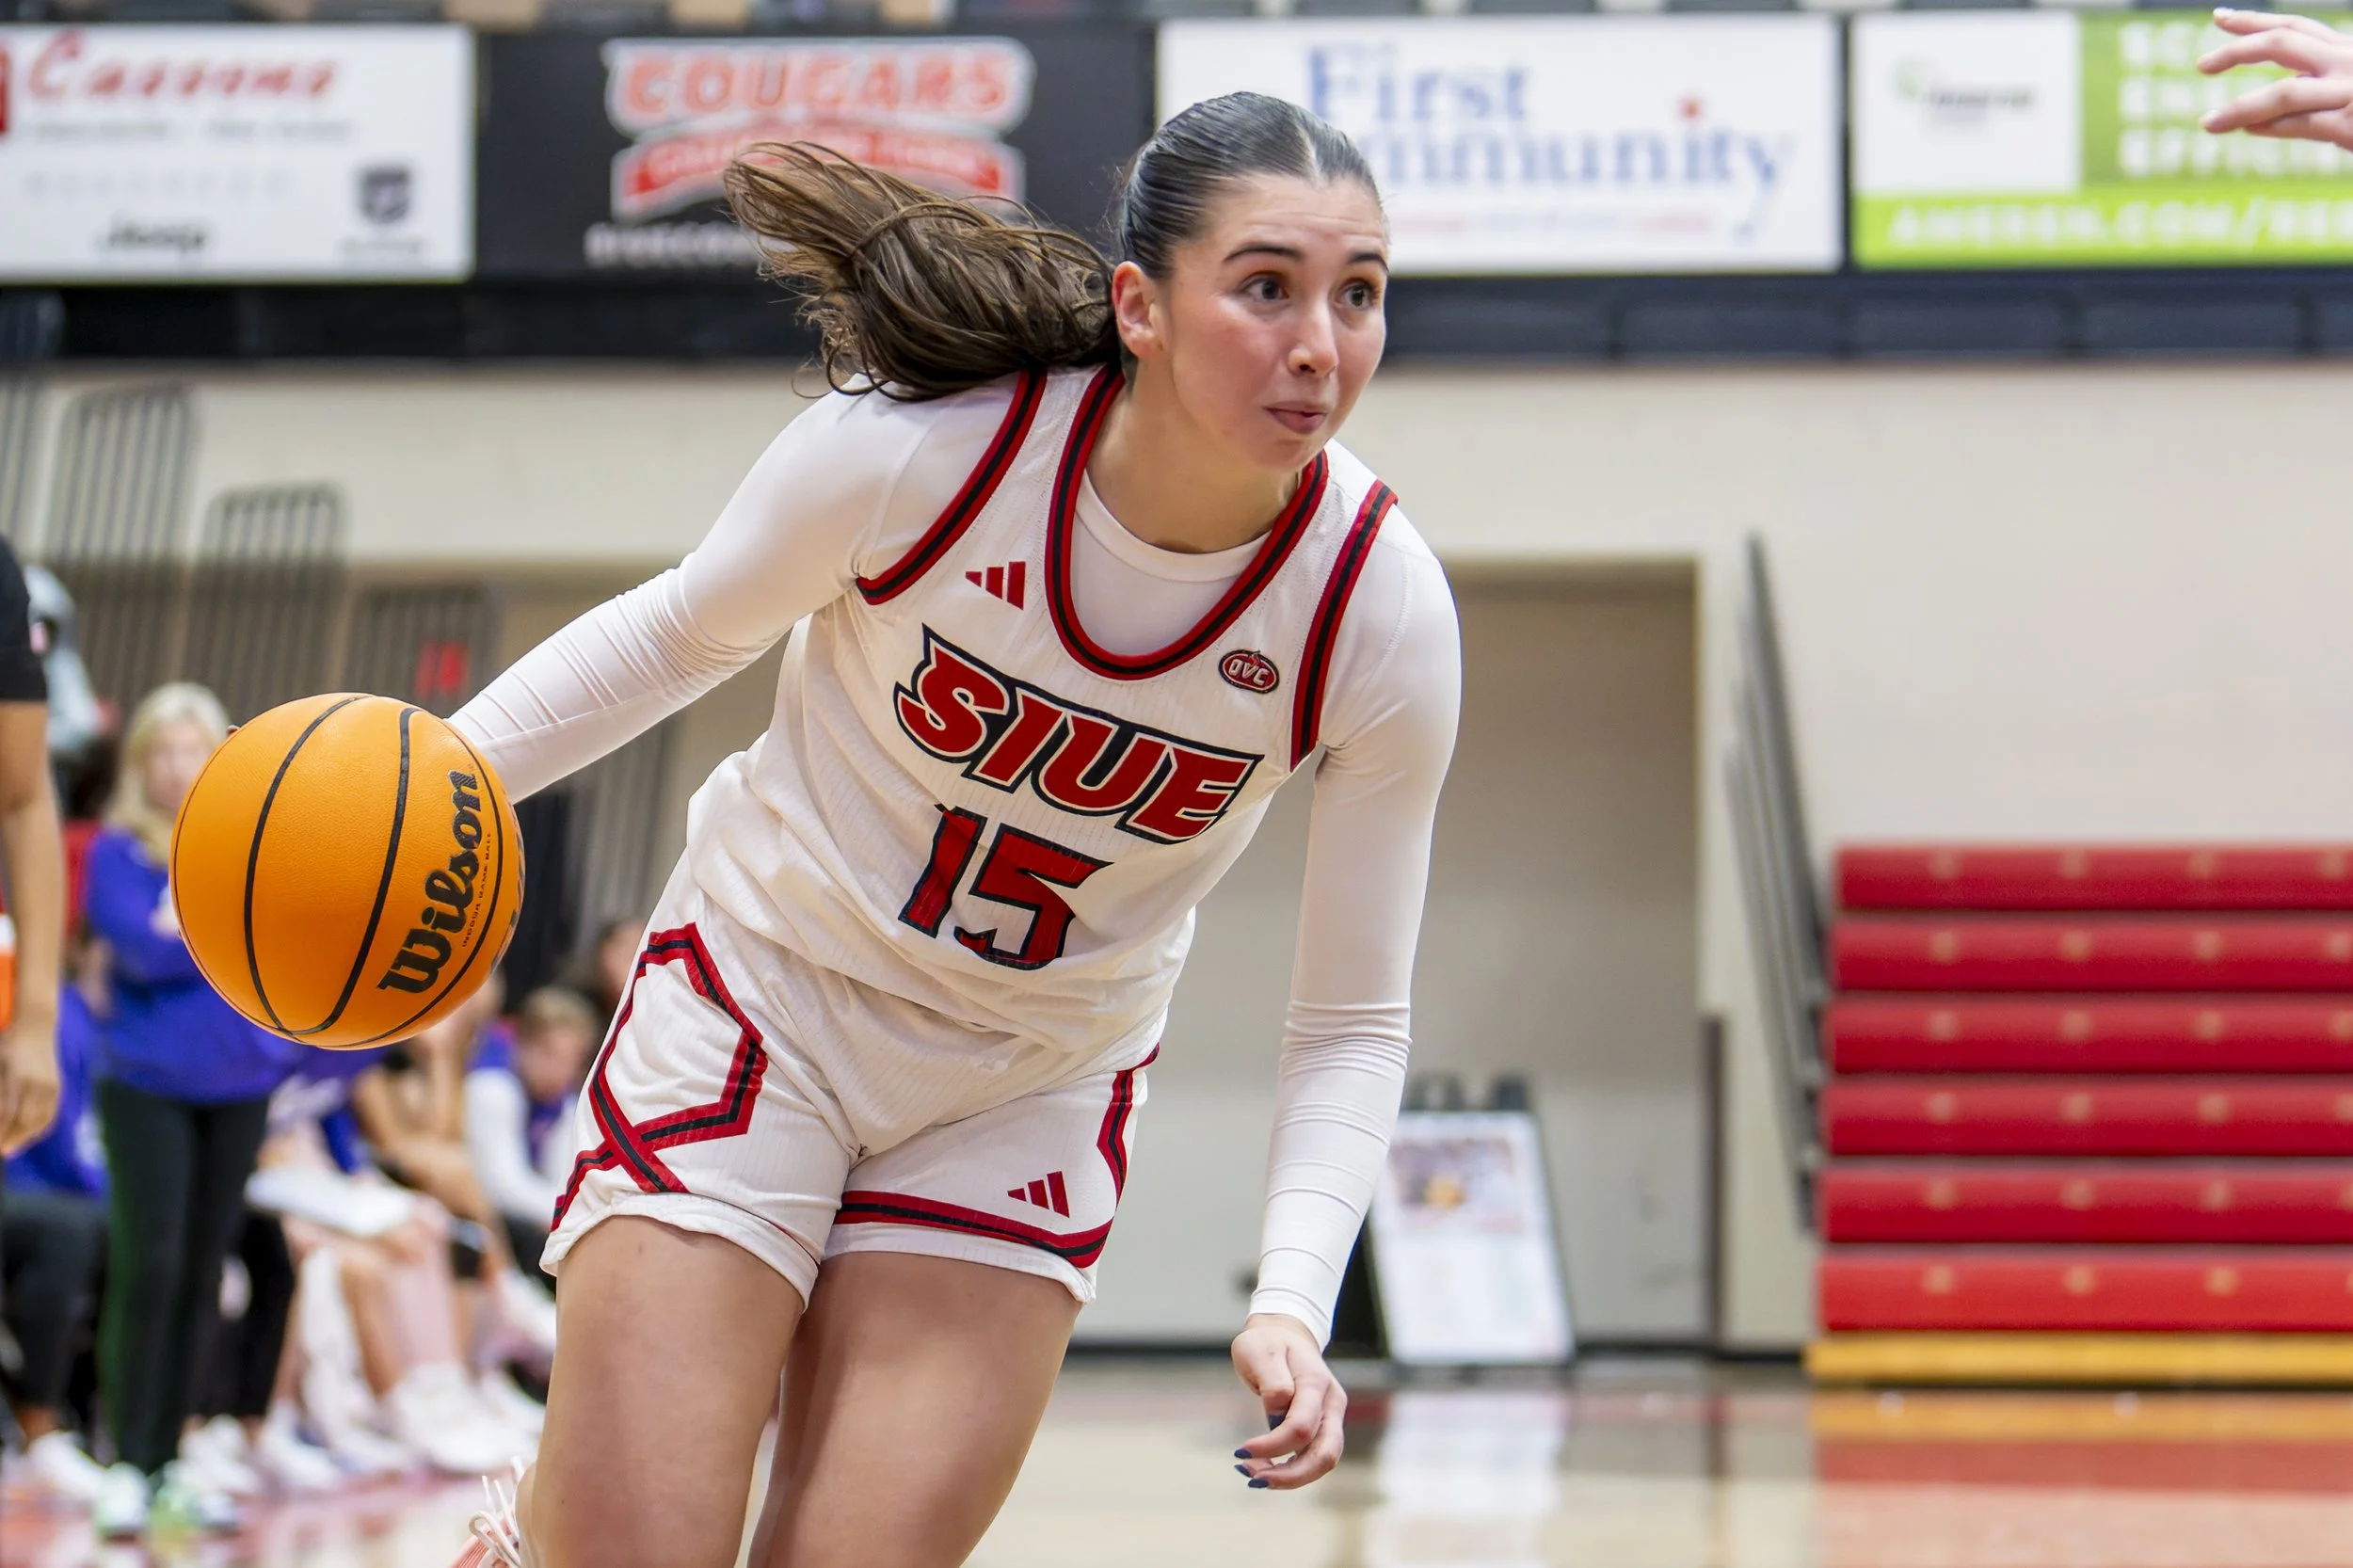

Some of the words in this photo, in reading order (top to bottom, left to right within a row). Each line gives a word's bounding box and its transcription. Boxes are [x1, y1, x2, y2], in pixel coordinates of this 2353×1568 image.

[621, 49, 1016, 120] COUGARS
[1303, 41, 1532, 121] First
[1357, 97, 1794, 243] mmunity
[894, 624, 1263, 843] SIUE
[377, 769, 483, 994] Wilson
[898, 804, 1114, 970] 15
